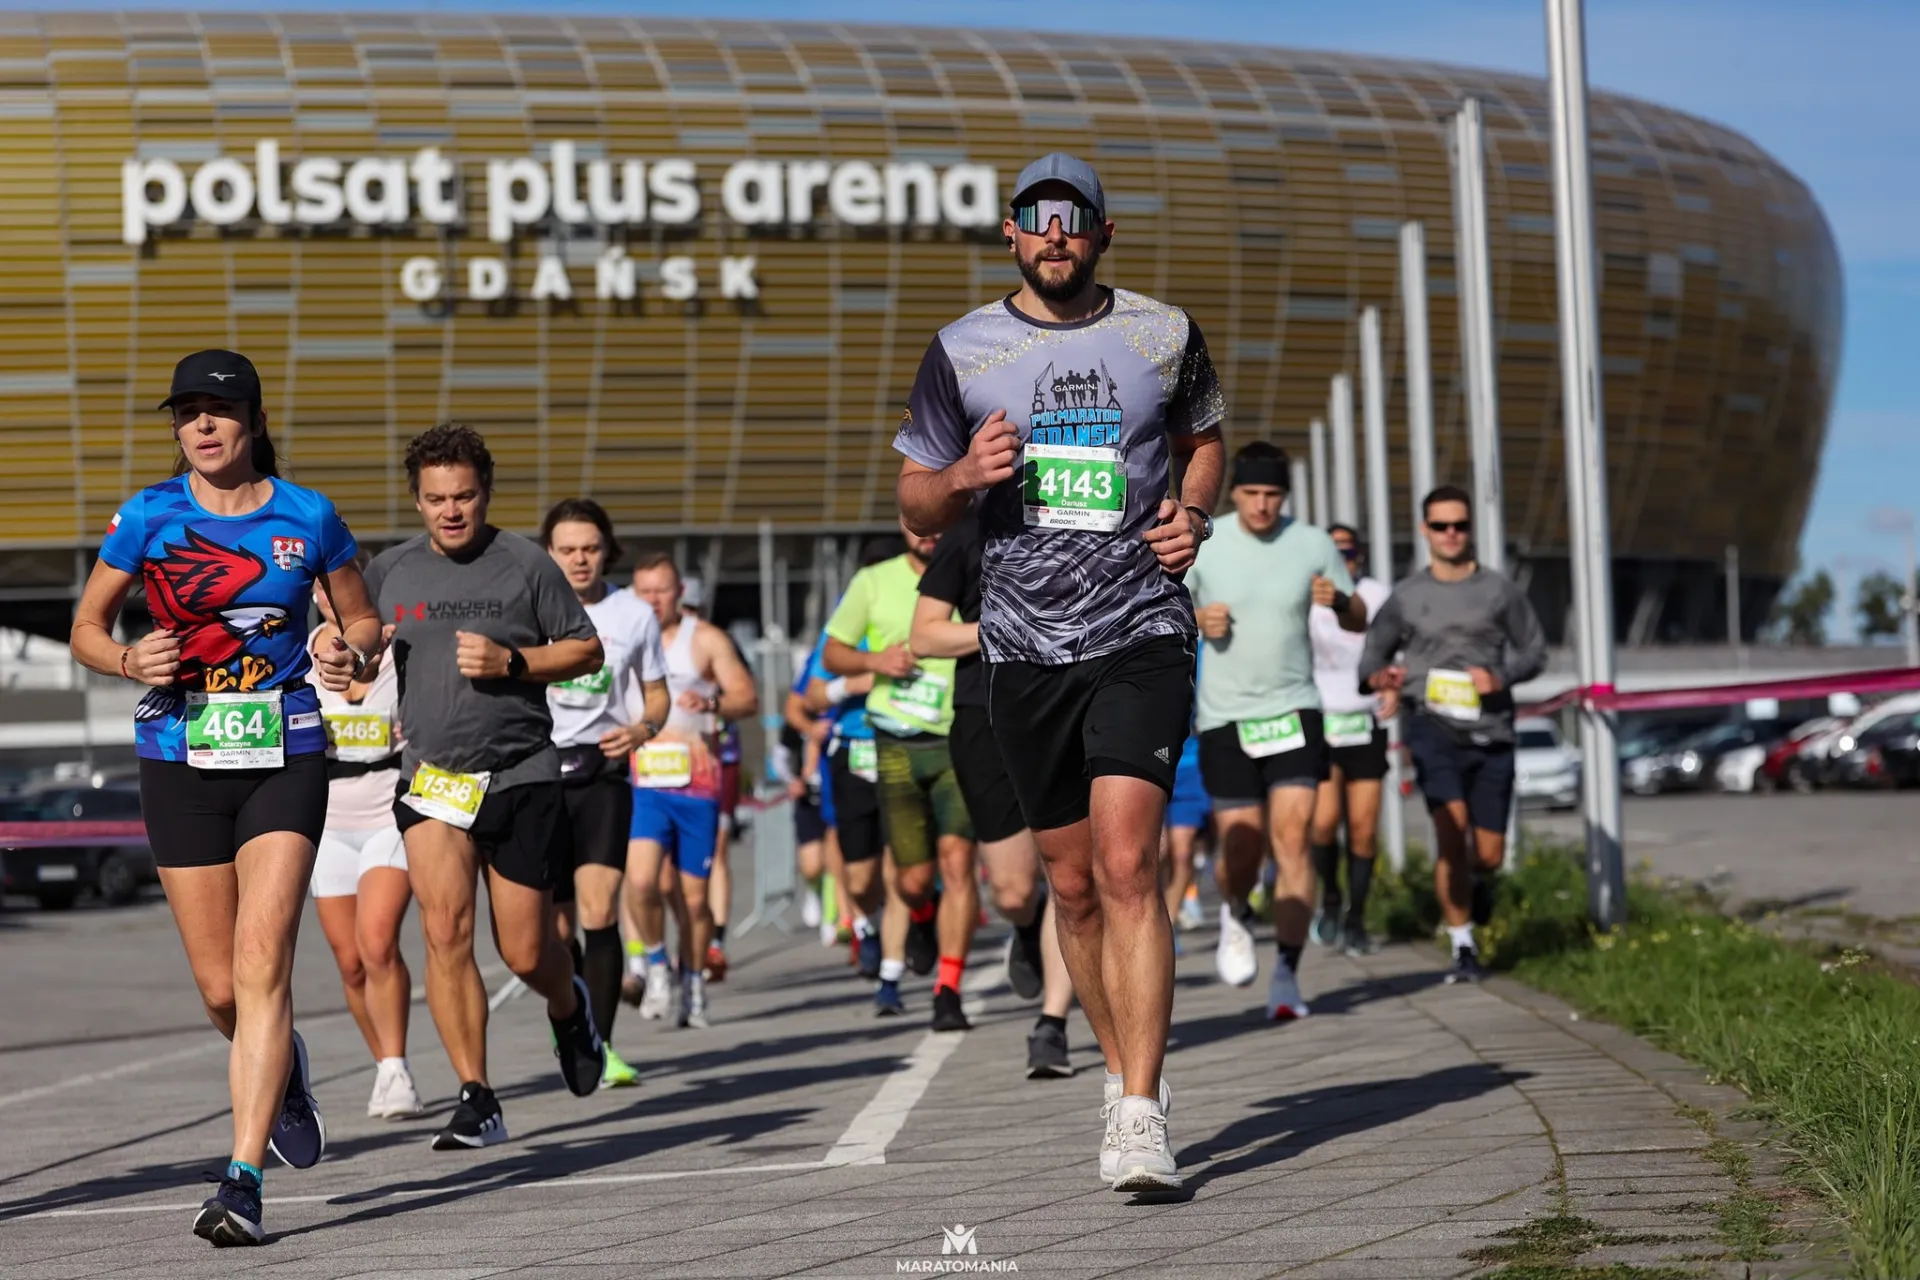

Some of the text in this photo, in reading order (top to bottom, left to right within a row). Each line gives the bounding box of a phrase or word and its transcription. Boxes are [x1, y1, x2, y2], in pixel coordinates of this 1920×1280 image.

[122, 139, 999, 245] polsat plus arena
[401, 246, 760, 301] GDAŃSK
[1054, 383, 1096, 393] GARMIN
[1040, 467, 1112, 500] 4143
[1061, 499, 1088, 508] Dariusz
[1056, 509, 1090, 517] GARMIN
[1049, 518, 1077, 526] BROOKS
[427, 600, 503, 611] UNDER
[428, 610, 503, 620] ARMOUR
[202, 709, 265, 741] 464
[423, 774, 472, 803] 1538
